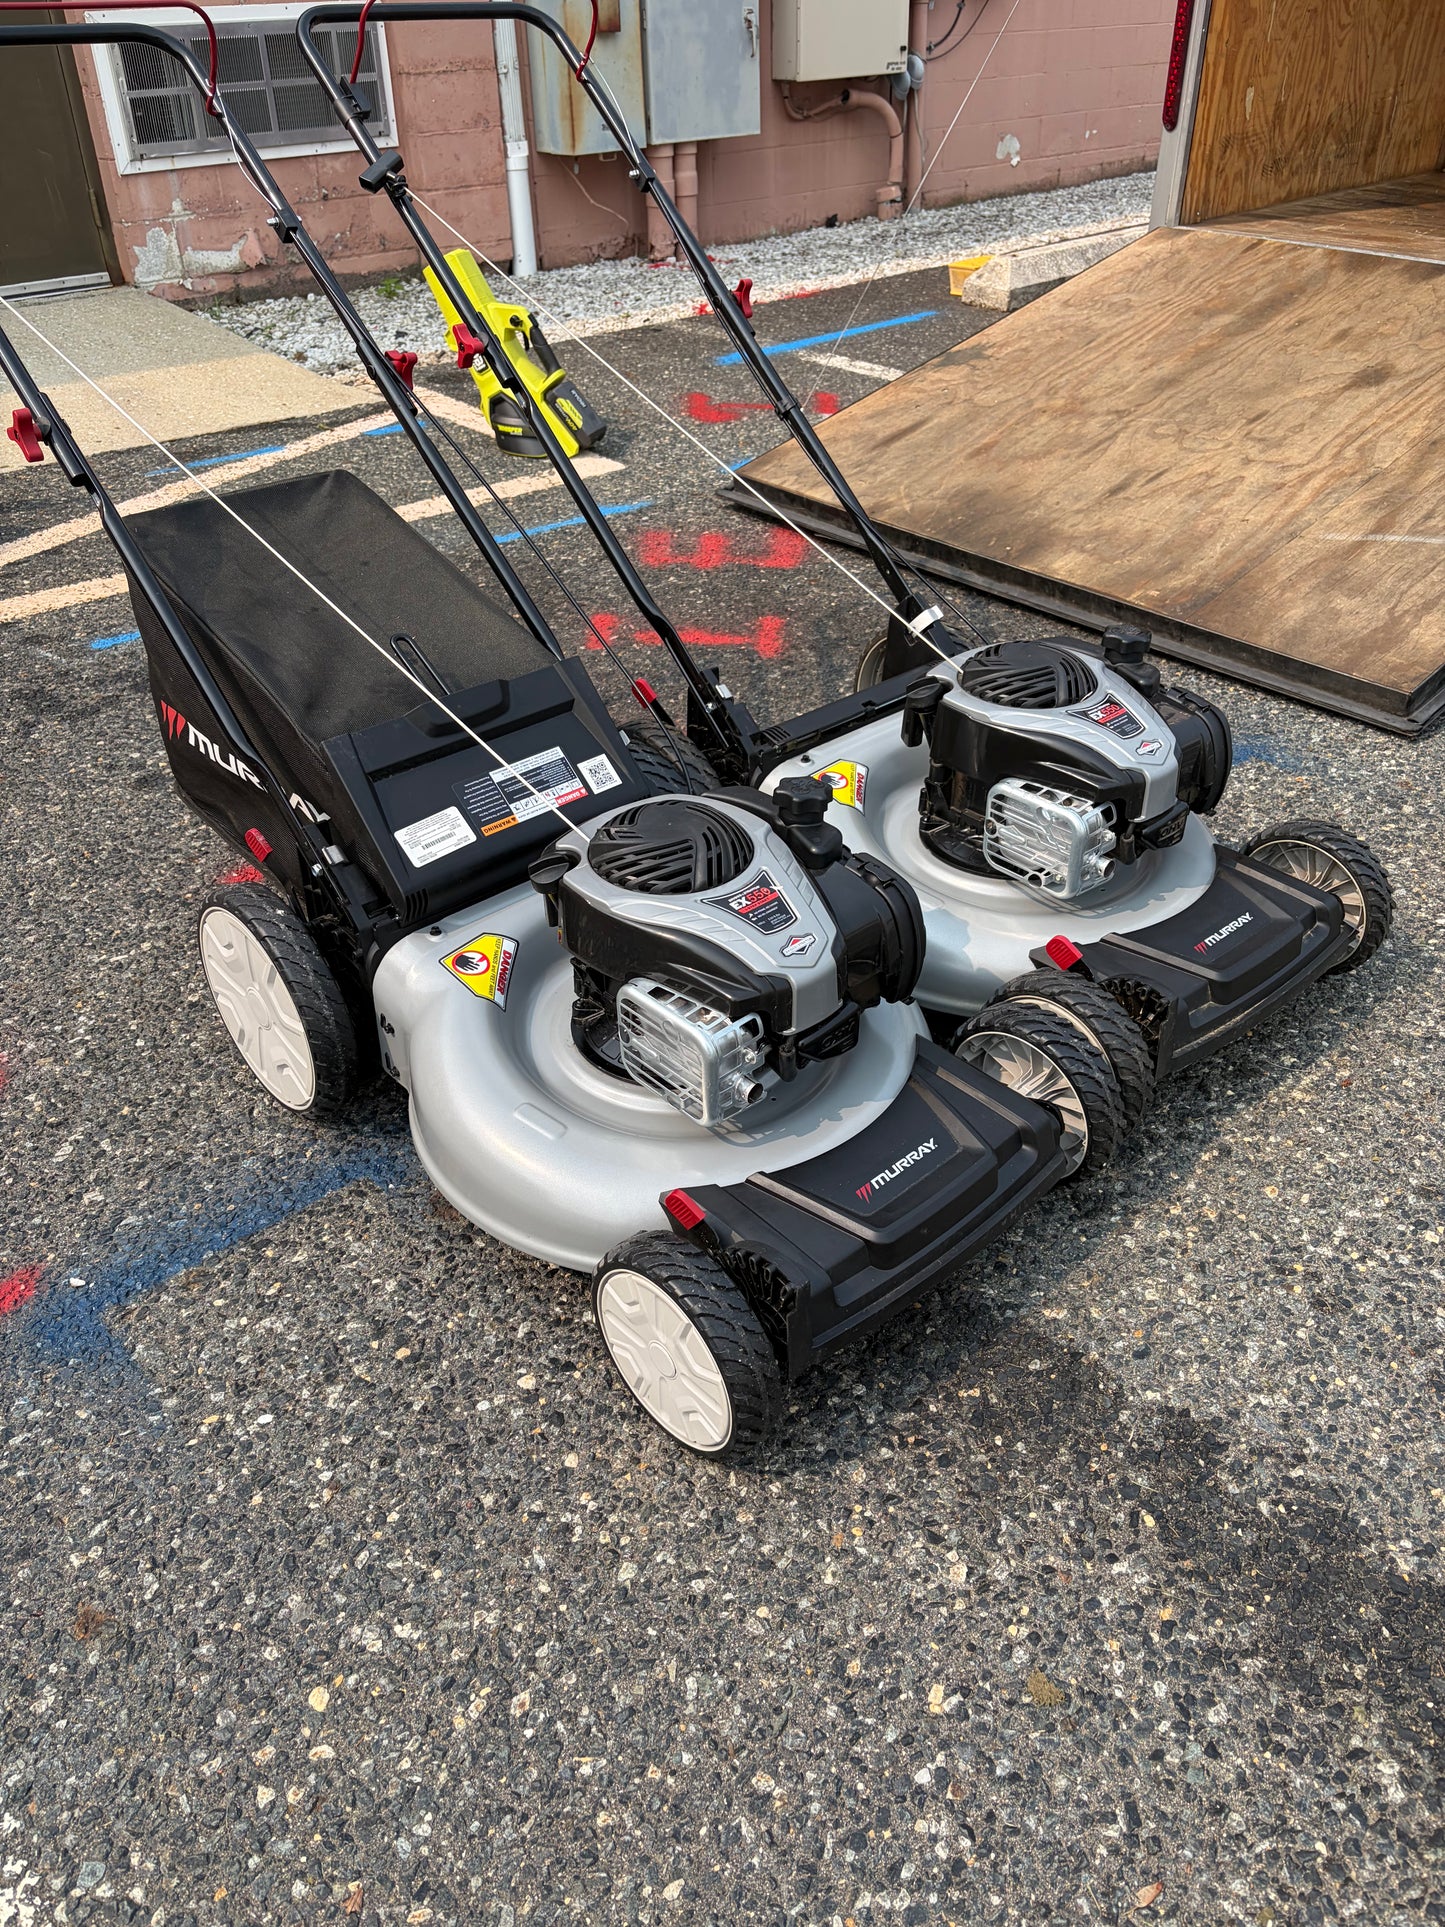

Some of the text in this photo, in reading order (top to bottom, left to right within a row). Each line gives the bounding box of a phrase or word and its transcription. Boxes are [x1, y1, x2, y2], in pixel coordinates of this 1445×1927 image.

[1088, 703, 1121, 721] EX550
[187, 721, 331, 823] MURAY
[856, 772, 865, 805] DANGER
[557, 790, 581, 805] DANGER
[483, 818, 513, 835] WARNING
[729, 887, 771, 911] EX550
[1204, 911, 1252, 946] MURRAY
[497, 950, 512, 995] DANGER
[871, 1137, 936, 1190] MURRAY
